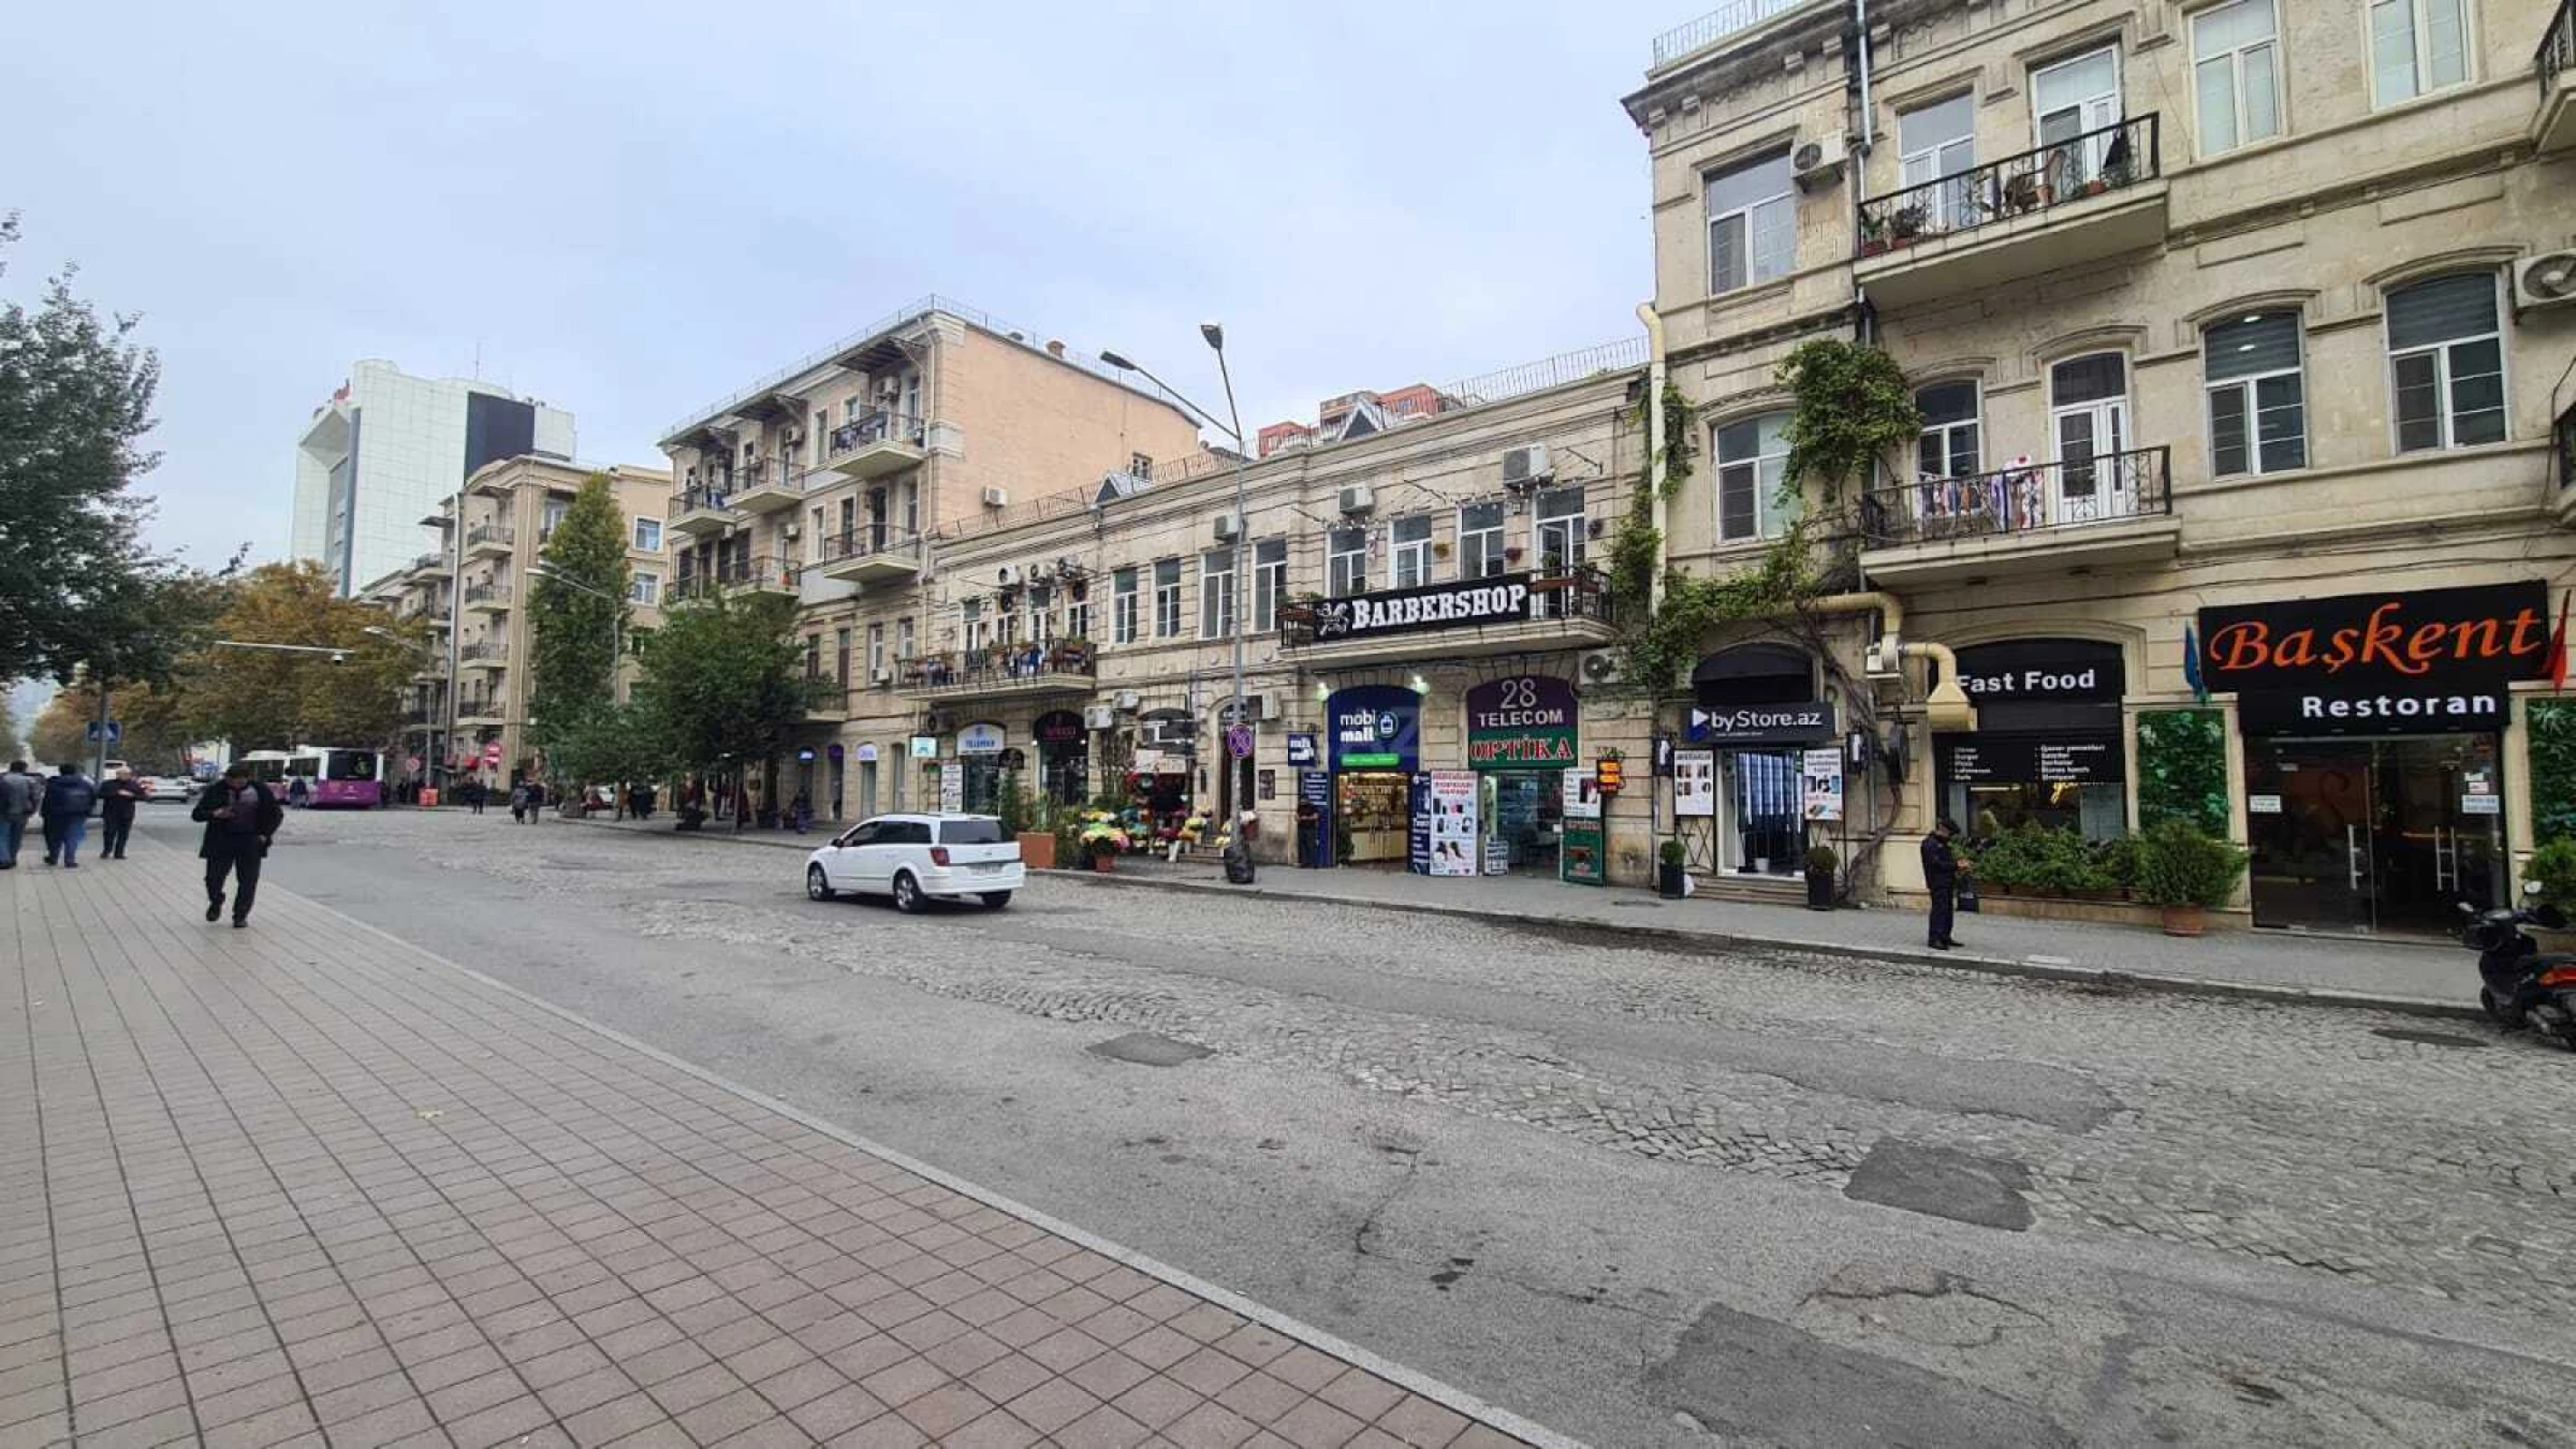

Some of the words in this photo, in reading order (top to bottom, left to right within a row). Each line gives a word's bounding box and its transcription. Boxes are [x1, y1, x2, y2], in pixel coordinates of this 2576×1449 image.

[1351, 584, 1526, 630] BARBERSHOP
[2209, 602, 2543, 674] Başkent
[1956, 672, 2014, 693] Fast
[2025, 669, 2096, 690] Food
[1500, 678, 1537, 709] 28
[1340, 709, 1376, 725] mobi
[1478, 708, 1563, 728] TELECOM
[2302, 695, 2495, 718] Restoran
[1711, 710, 1823, 731] byStore.az
[1340, 726, 1374, 742] mall
